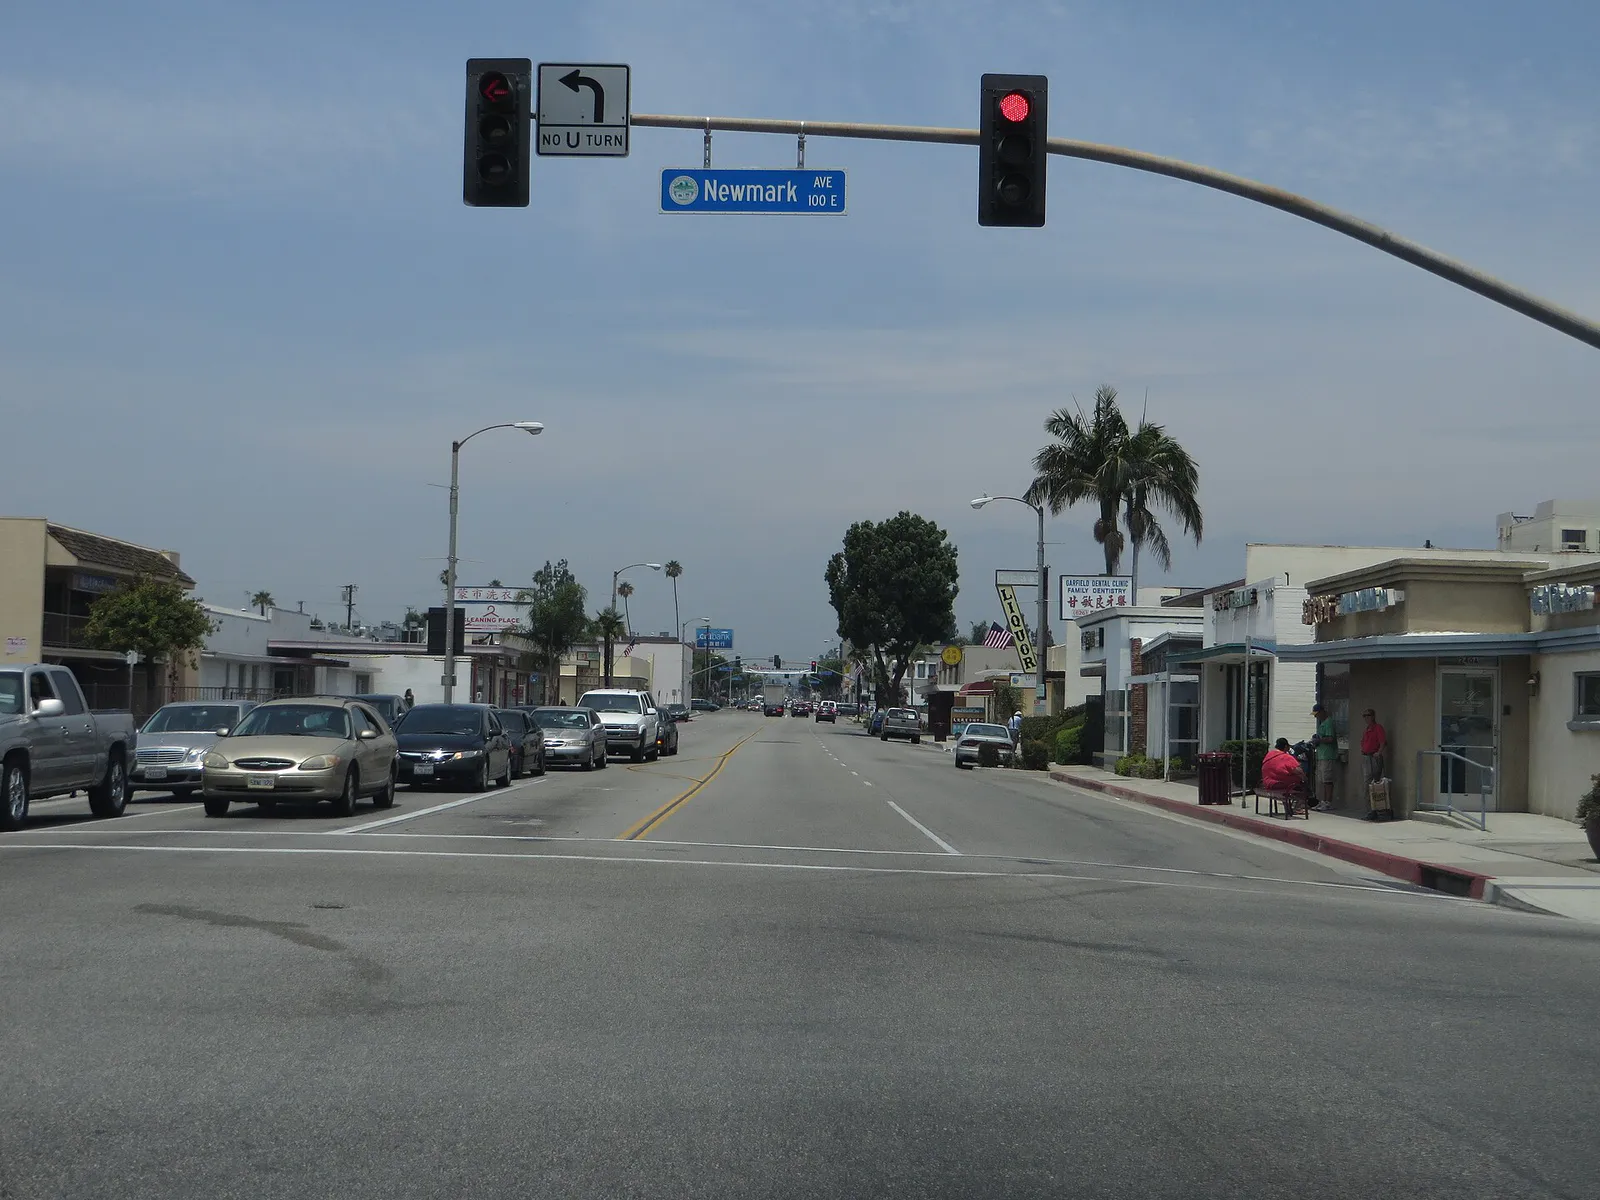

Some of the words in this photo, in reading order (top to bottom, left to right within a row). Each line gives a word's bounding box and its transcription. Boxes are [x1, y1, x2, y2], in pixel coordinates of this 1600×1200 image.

[542, 134, 560, 146] NO
[566, 131, 580, 149] U
[586, 134, 623, 147] TURN
[704, 179, 798, 202] Newmark
[813, 176, 833, 188] AVE
[808, 195, 826, 206] 100
[831, 195, 837, 207] E
[1065, 579, 1090, 587] GARFIELD
[1000, 589, 1036, 670] LIQUOR
